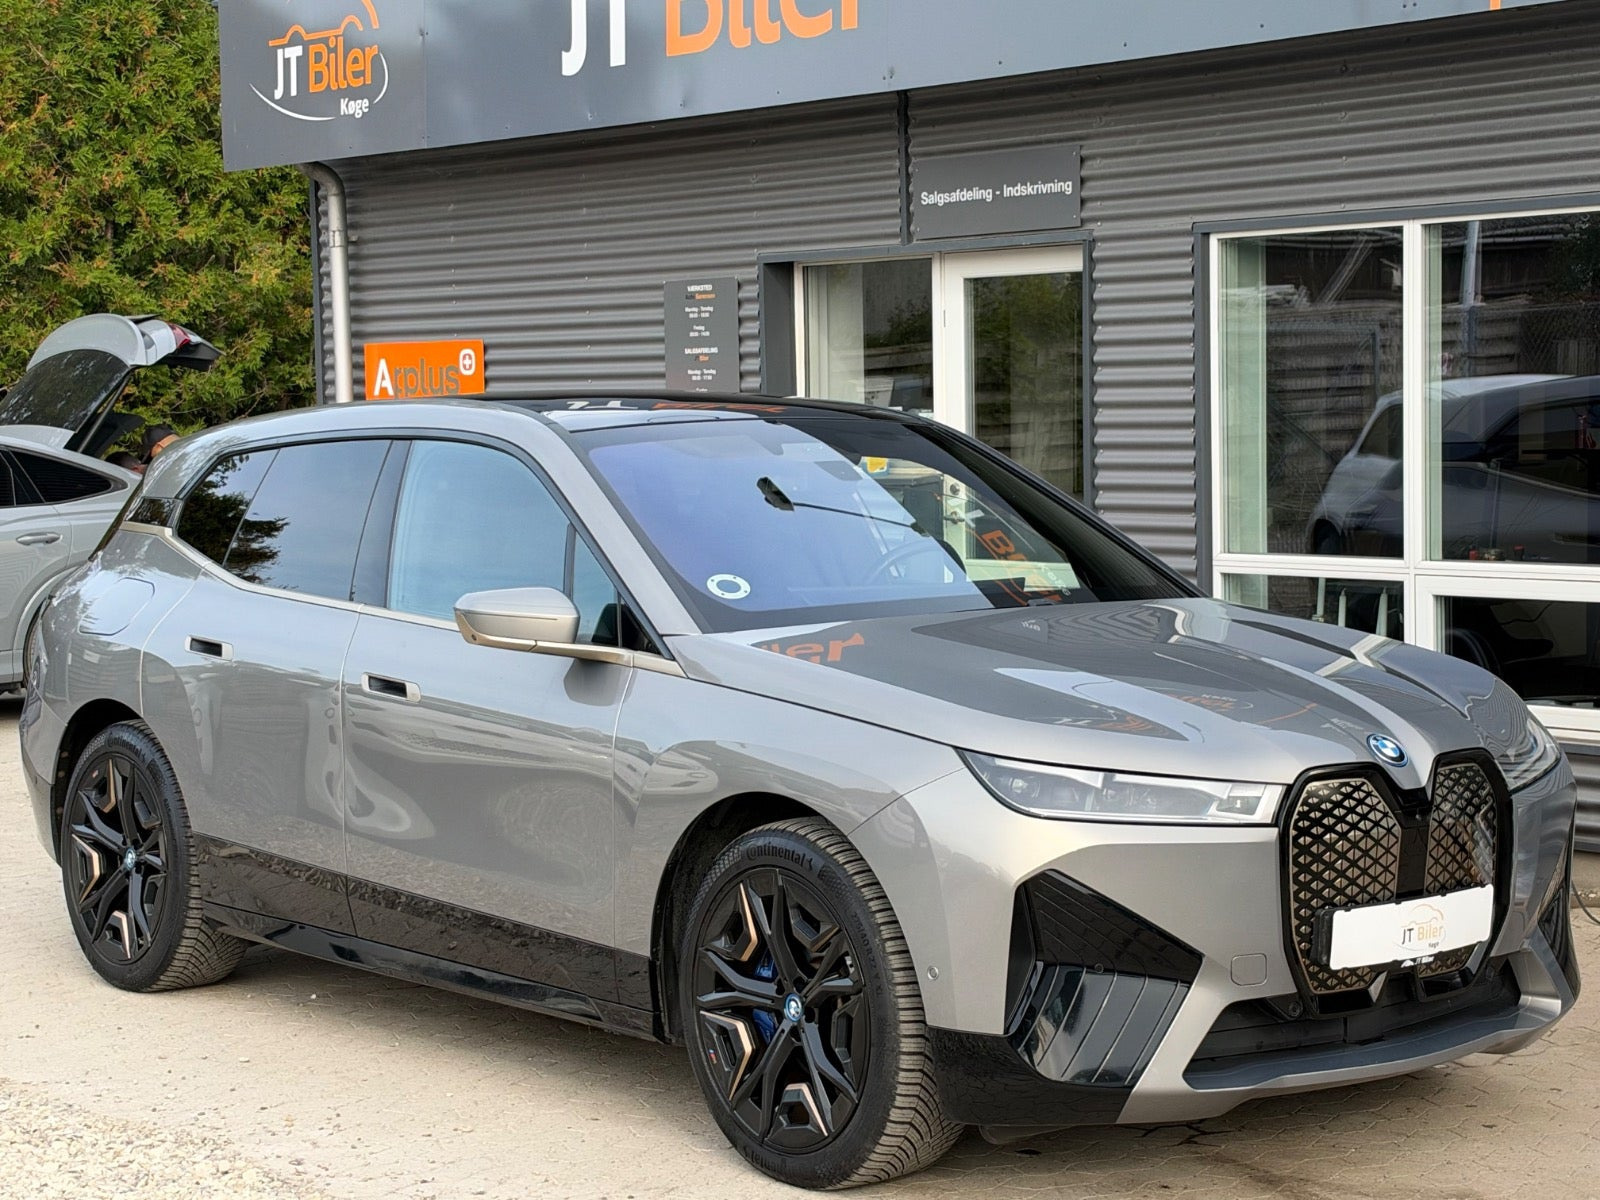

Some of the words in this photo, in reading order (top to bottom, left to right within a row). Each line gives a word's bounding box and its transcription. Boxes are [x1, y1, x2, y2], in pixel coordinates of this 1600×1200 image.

[274, 45, 303, 100] JT
[308, 36, 379, 93] Biler
[340, 98, 370, 119] Køge
[921, 187, 993, 206] Salgsafdeling
[1003, 179, 1073, 198] Indskrivning
[746, 841, 807, 868] Continental
[1402, 928, 1414, 945] JT
[1417, 924, 1443, 941] Biler
